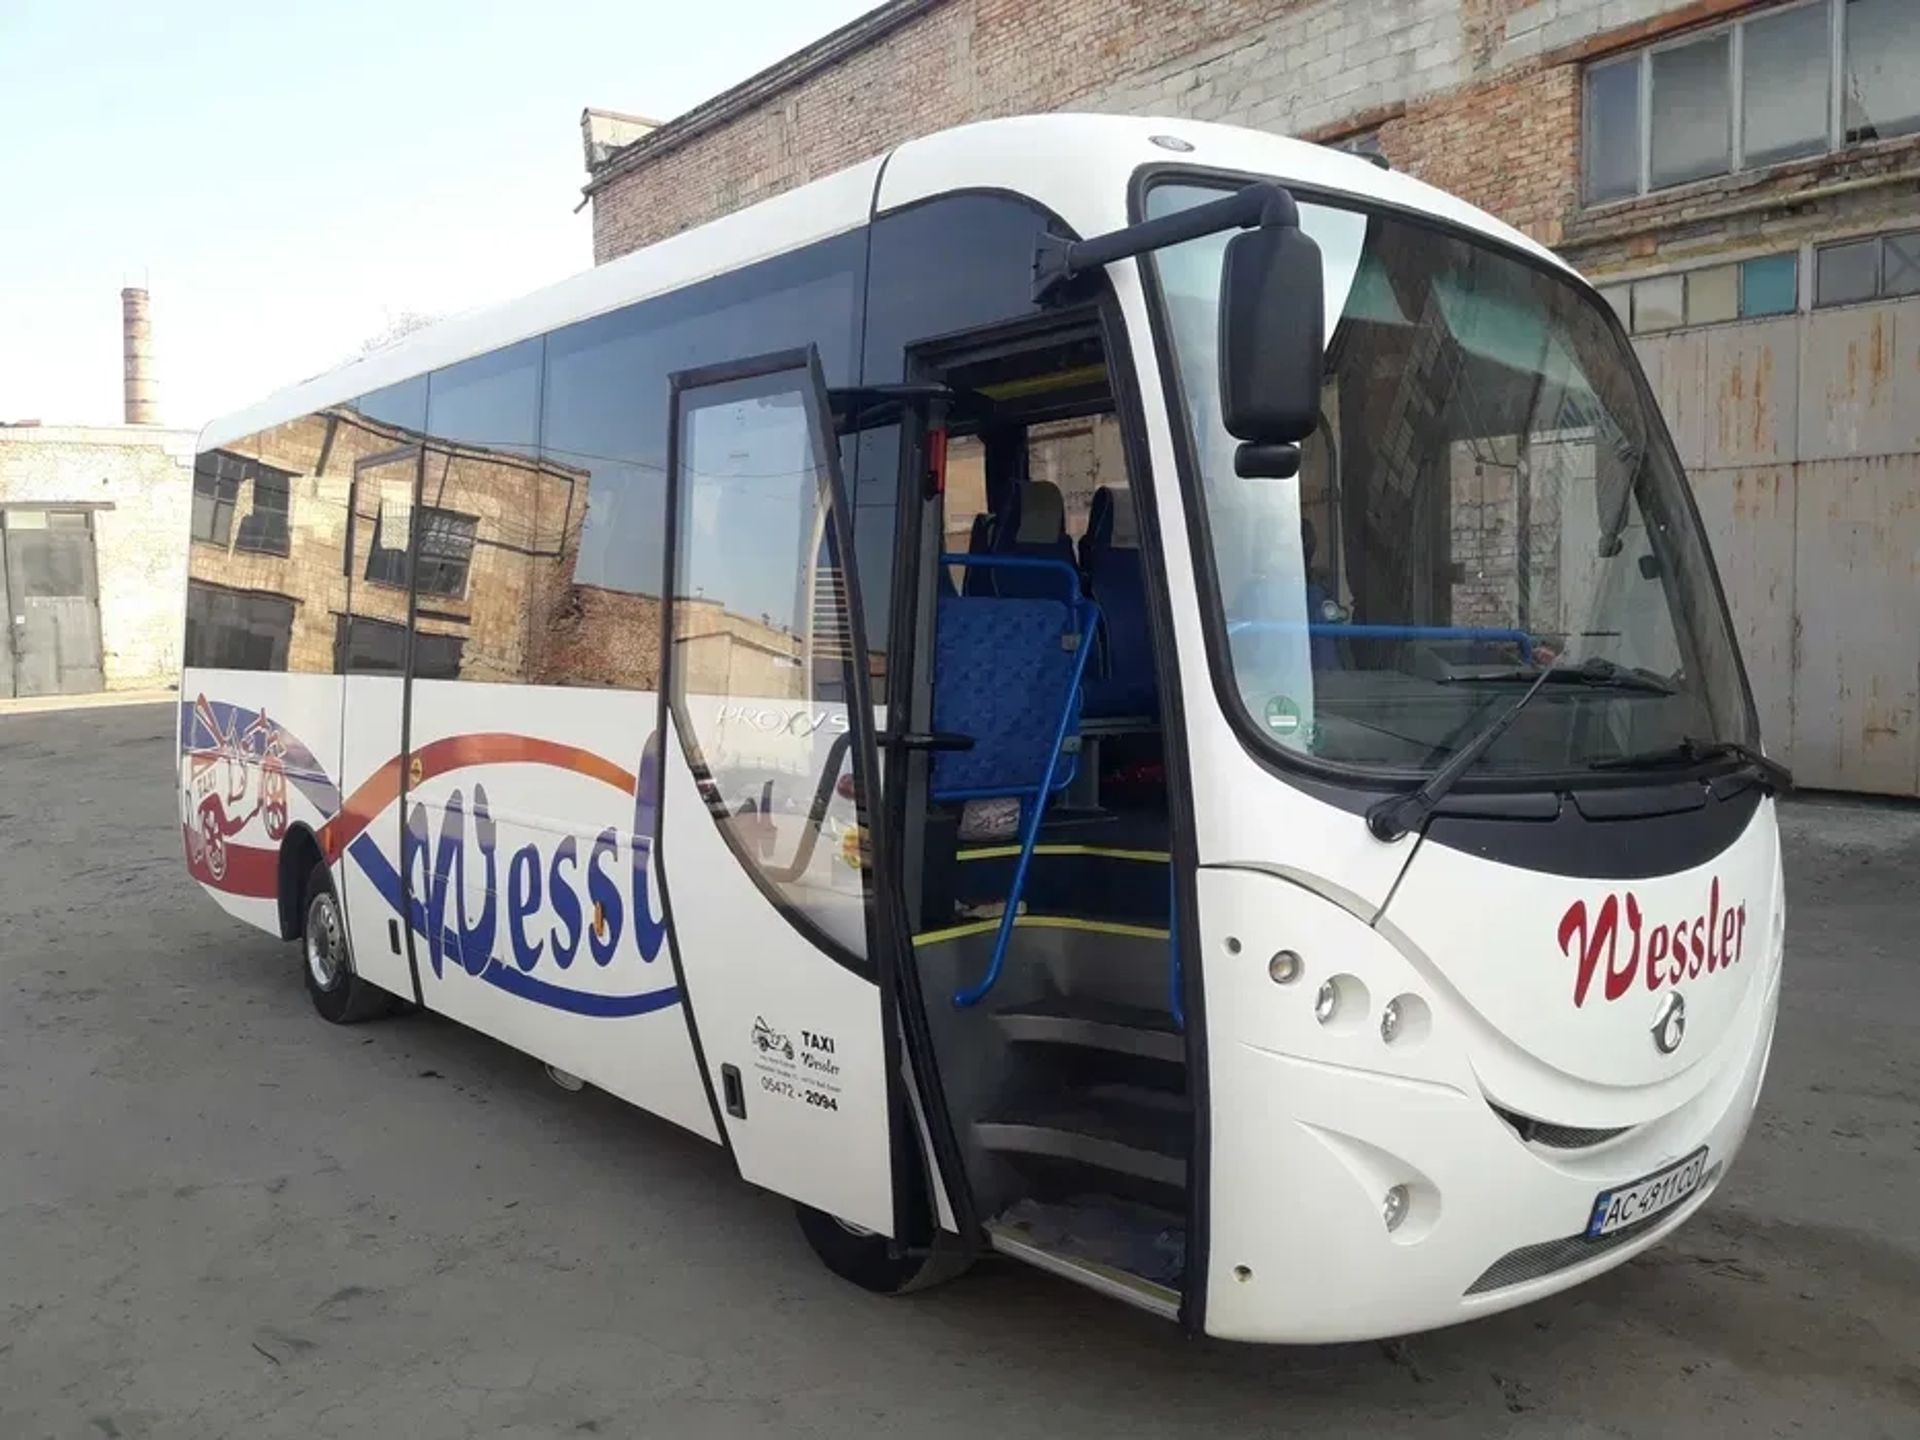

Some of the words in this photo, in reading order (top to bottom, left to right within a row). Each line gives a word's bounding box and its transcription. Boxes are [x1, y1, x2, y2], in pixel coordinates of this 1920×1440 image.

[716, 703, 850, 738] PROXYS
[1557, 875, 1746, 1008] Wessler
[801, 1030, 835, 1054] TAXI
[805, 1089, 839, 1112] 2094
[1605, 1192, 1637, 1227] AC
[1638, 1173, 1678, 1214] 4911
